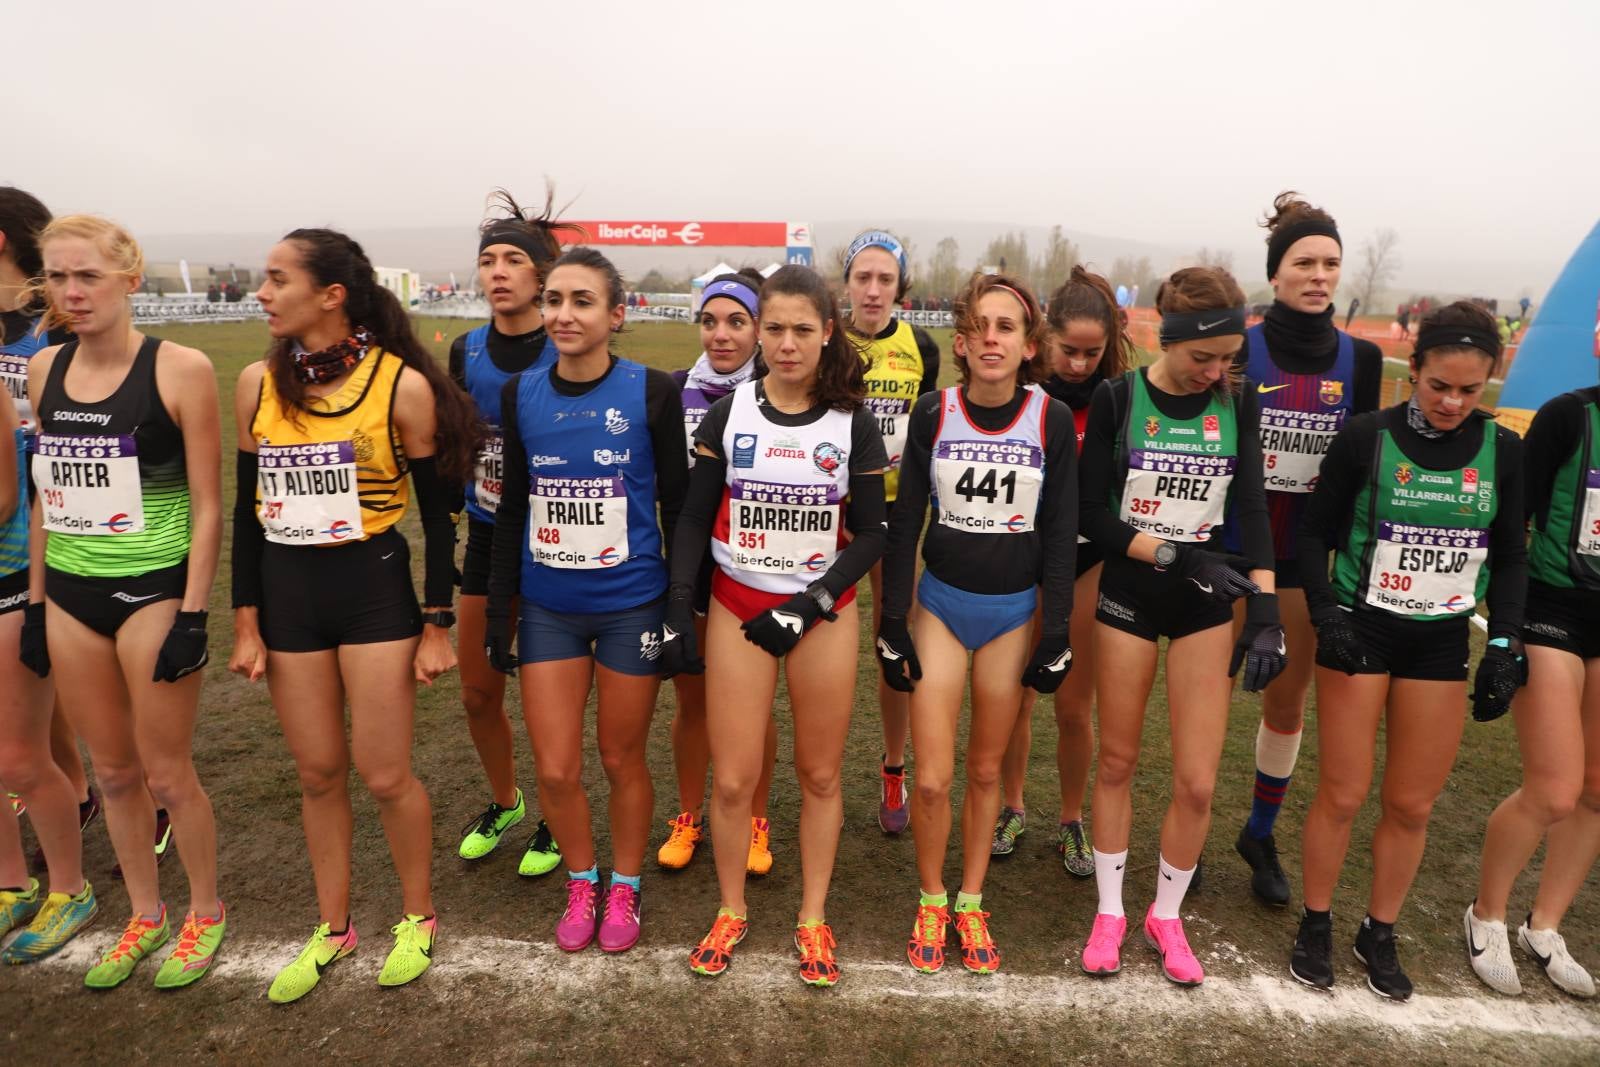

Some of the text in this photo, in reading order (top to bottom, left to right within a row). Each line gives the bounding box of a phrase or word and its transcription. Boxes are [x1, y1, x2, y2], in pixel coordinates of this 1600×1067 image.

[598, 224, 667, 242] iberCaja
[53, 410, 112, 426] saucony
[1262, 407, 1338, 422] DIPUTACIÓN
[1260, 415, 1336, 431] BURGOS
[40, 434, 120, 448] DIPUTACIÓN
[949, 442, 1031, 456] DIPUTACIÓN
[1144, 440, 1205, 452] VILLARREAL
[1260, 427, 1337, 455] ERNANDE
[40, 444, 121, 458] BURGOS
[948, 451, 1031, 466] BURGOS
[1143, 451, 1229, 467] DIPUTACIÓN
[51, 461, 111, 488] ARTER
[1142, 460, 1227, 476] BURGOS
[285, 467, 350, 497] ALIBOU
[537, 476, 613, 489] DIPUTACIÓN
[743, 481, 827, 496] DIPUTACIÓN
[955, 466, 1017, 505] 441
[1155, 475, 1213, 502] PEREZ
[1264, 476, 1297, 488] rCaja
[536, 486, 614, 498] BURGOS
[742, 491, 828, 506] BURGOS
[1393, 487, 1457, 503] VILLARREAL
[547, 501, 605, 525] FRAILE
[1129, 497, 1161, 516] 357
[739, 505, 832, 532] BARREIRO
[944, 510, 995, 530] iberCaja
[1127, 515, 1184, 537] iberCaja
[536, 527, 560, 544] 428
[1391, 524, 1480, 539] DIPUTACIÓN
[738, 531, 766, 550] 351
[1390, 532, 1479, 548] BURGOS
[535, 547, 585, 565] iberCaja
[735, 552, 794, 571] iberCaja
[1398, 547, 1469, 574] ESPEJO
[1379, 571, 1412, 592] 330
[1376, 592, 1434, 612] iberCaja
